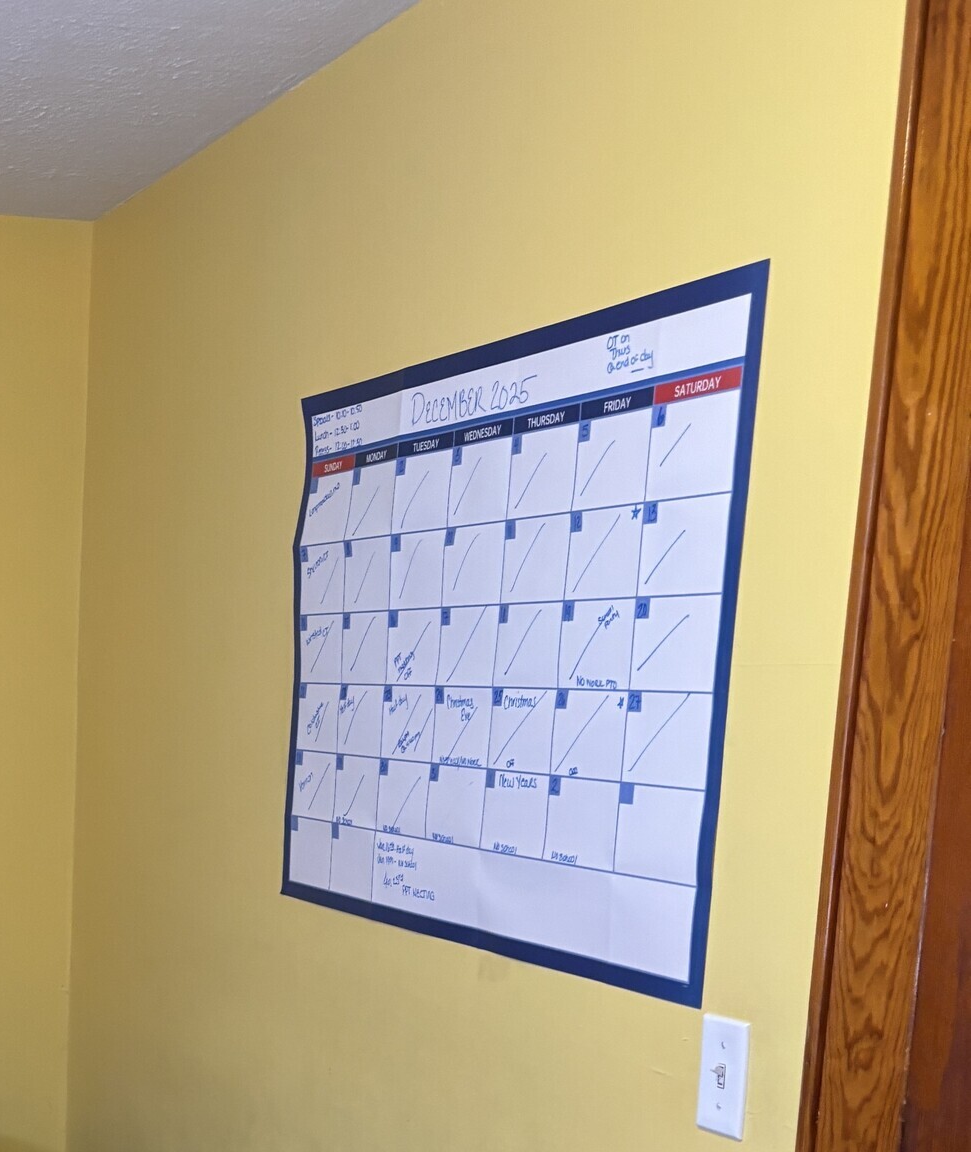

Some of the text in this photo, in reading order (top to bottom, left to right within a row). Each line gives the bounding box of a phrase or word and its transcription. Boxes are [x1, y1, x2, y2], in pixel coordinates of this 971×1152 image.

[606, 334, 630, 350] OT on
[411, 375, 538, 426] DECEMBER 2025
[324, 375, 722, 473] SUNDAY MONDAY TUESDAY WEDNESDAY THURSDAY FRIDAY SATURDAY
[657, 406, 666, 427] 6
[581, 423, 589, 438] 5
[503, 694, 537, 710] Christmas
[550, 777, 559, 794] 2
